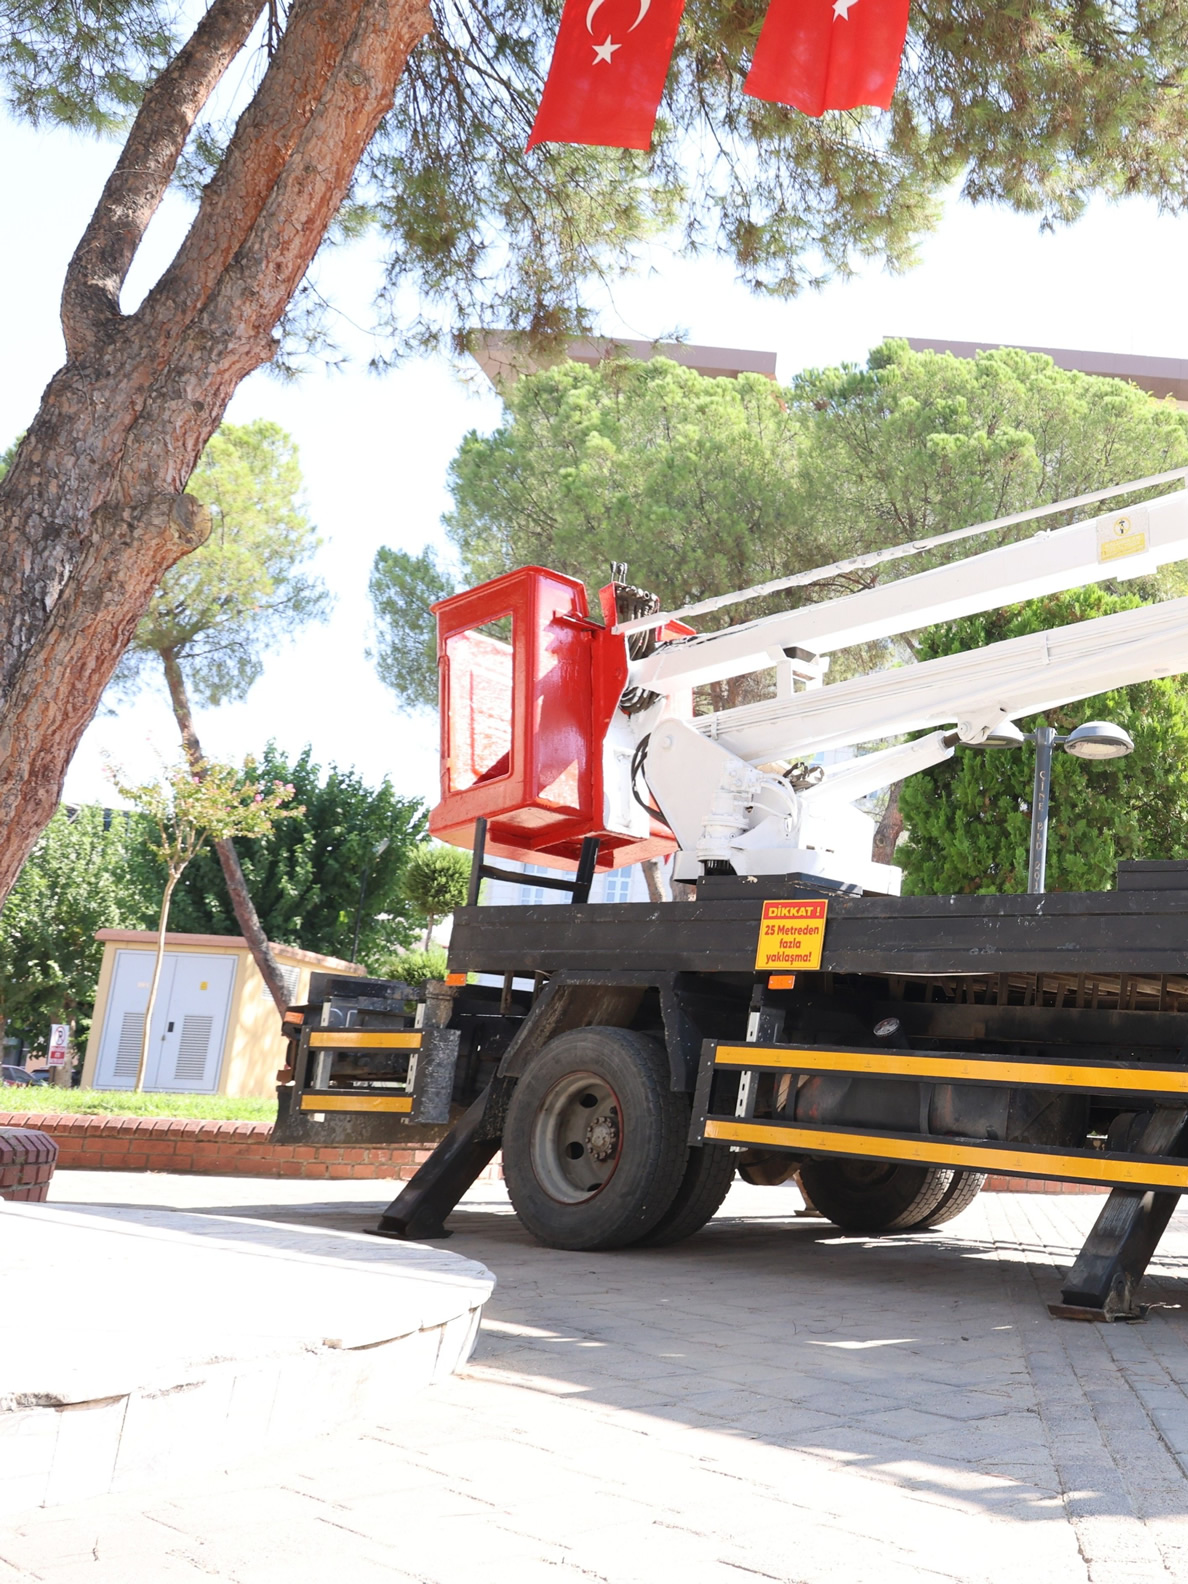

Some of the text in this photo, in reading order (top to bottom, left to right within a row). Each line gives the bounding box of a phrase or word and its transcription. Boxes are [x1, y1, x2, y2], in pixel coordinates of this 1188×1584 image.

[768, 905, 814, 916] DİKKAT
[764, 925, 819, 935] 25 Metreden
[779, 937, 801, 949] fazla
[765, 951, 812, 965] yaklaşma!
